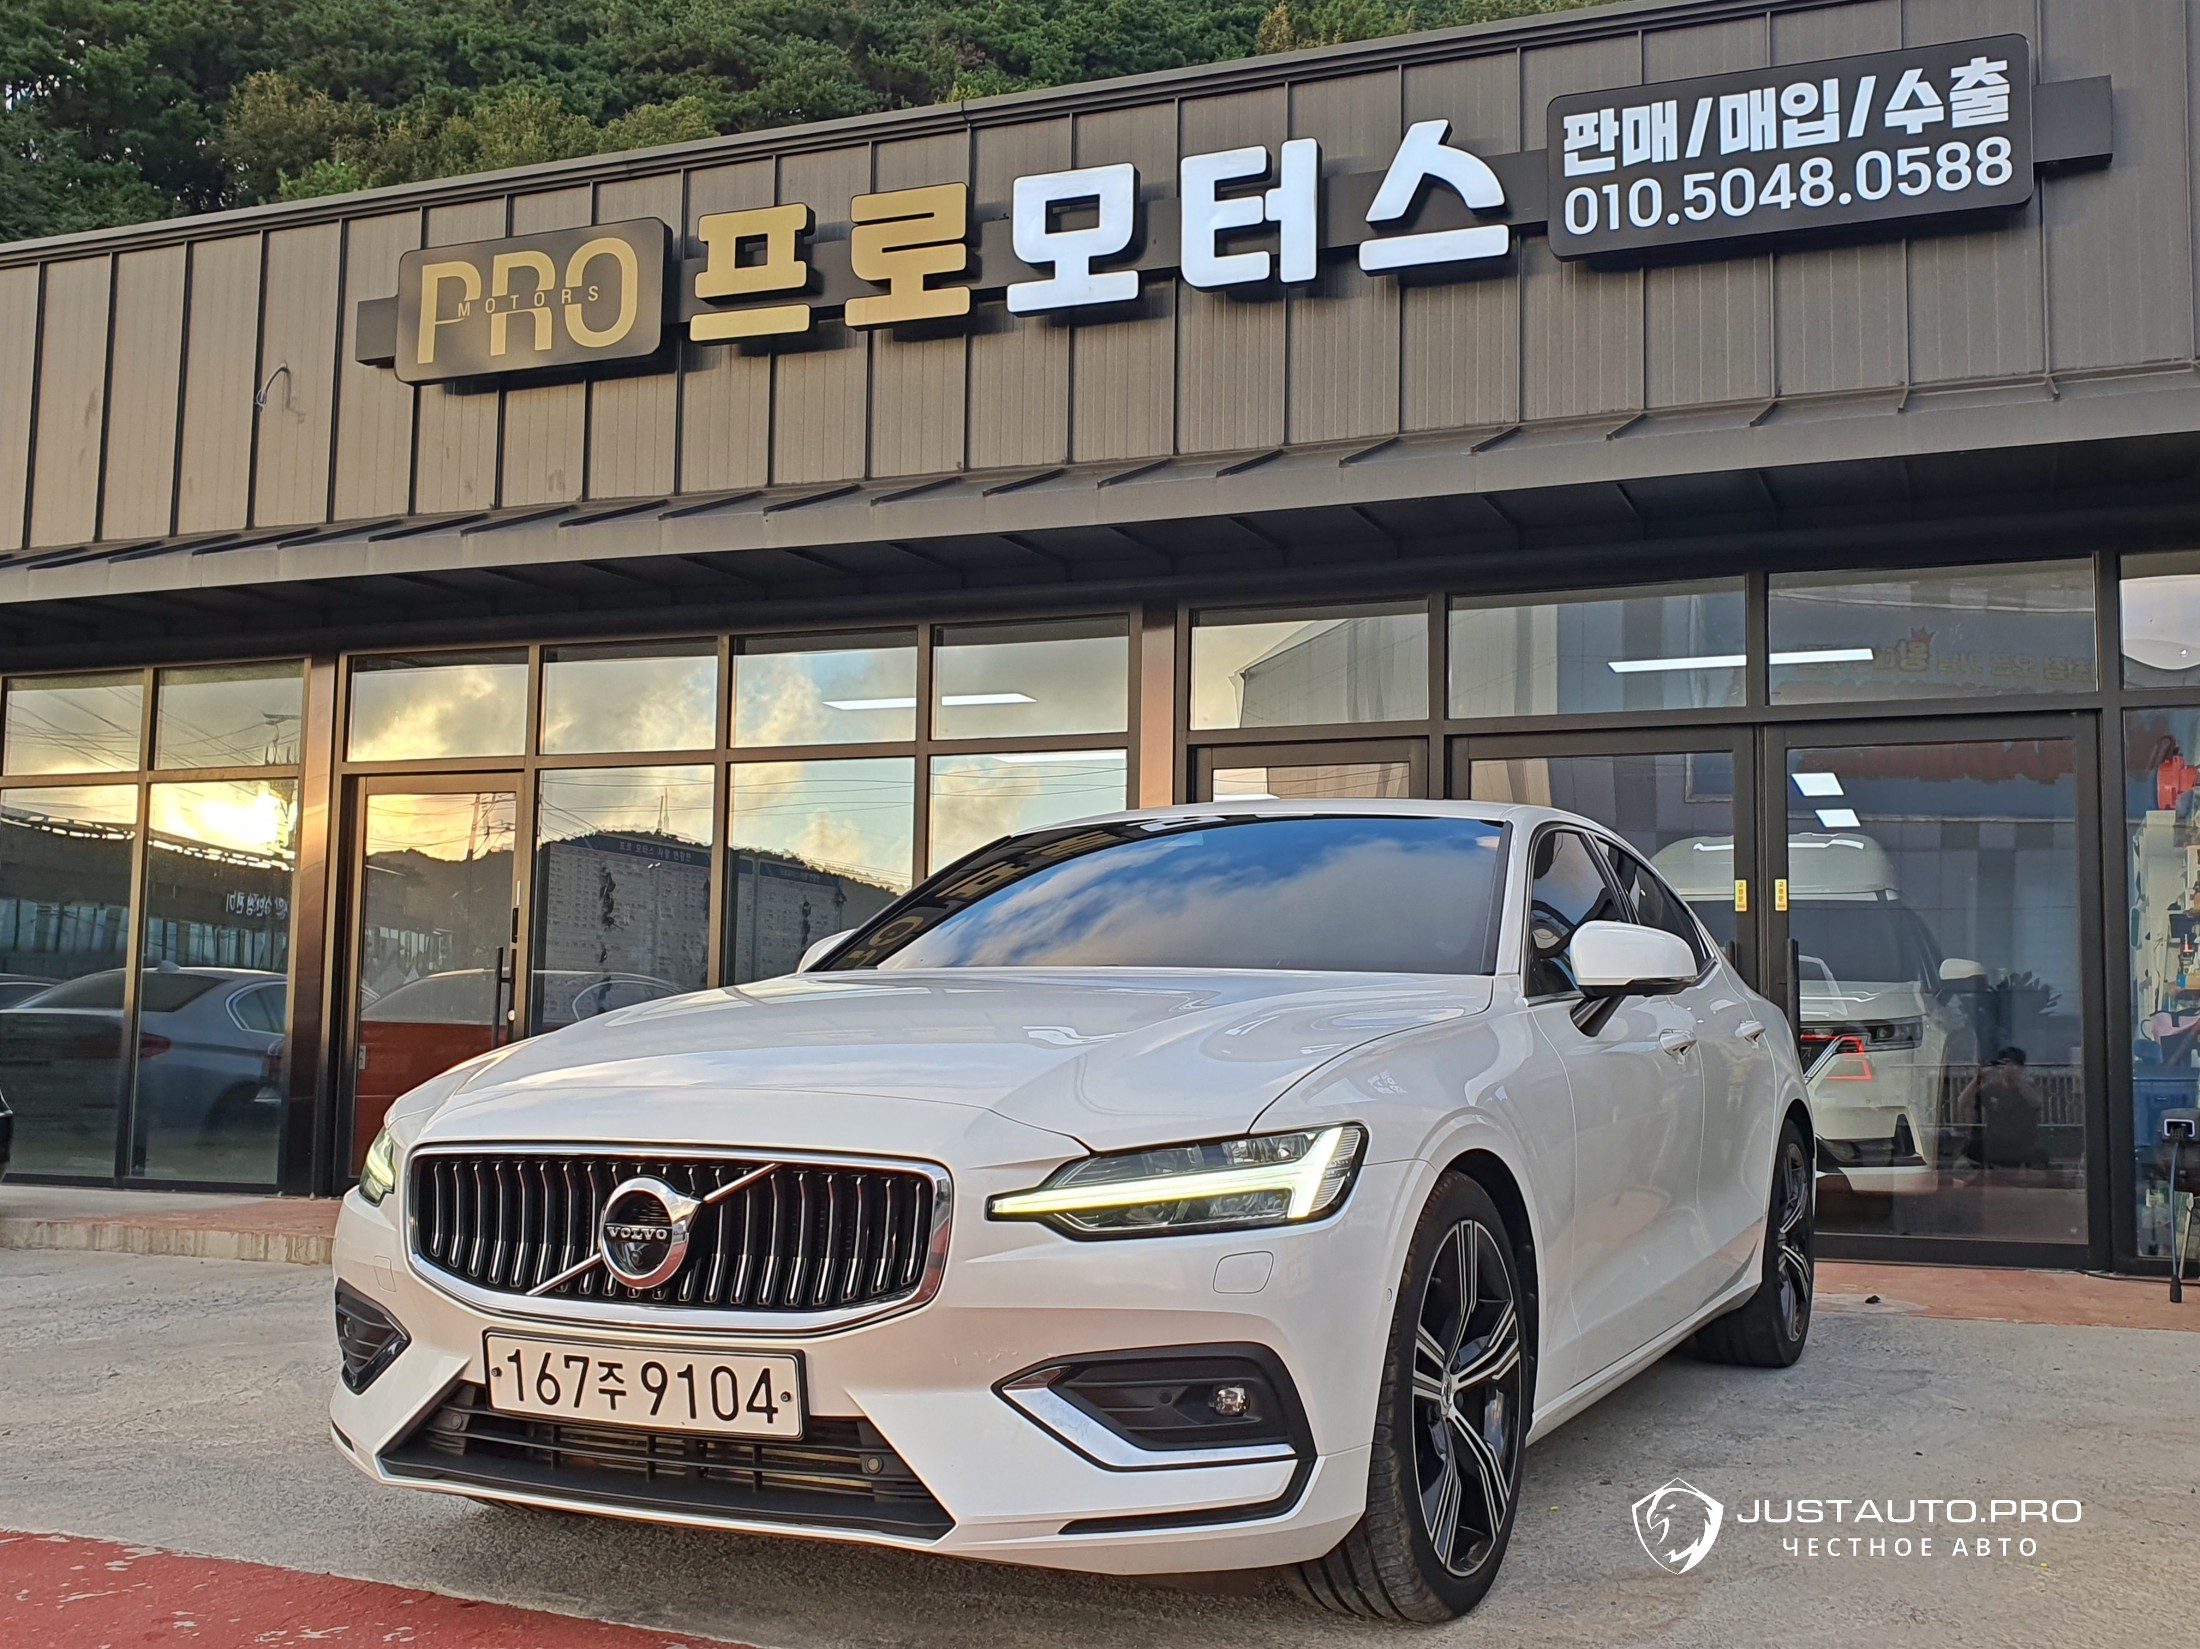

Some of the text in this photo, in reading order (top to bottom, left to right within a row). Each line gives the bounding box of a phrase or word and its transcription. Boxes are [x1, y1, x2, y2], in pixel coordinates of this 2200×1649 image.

[1563, 56, 2010, 175] 판매/매입/수출
[1563, 137, 2014, 237] 010.5048.0588
[417, 236, 639, 364] PRO
[458, 284, 600, 318] MOTORS
[606, 1226, 669, 1241] VOLVO
